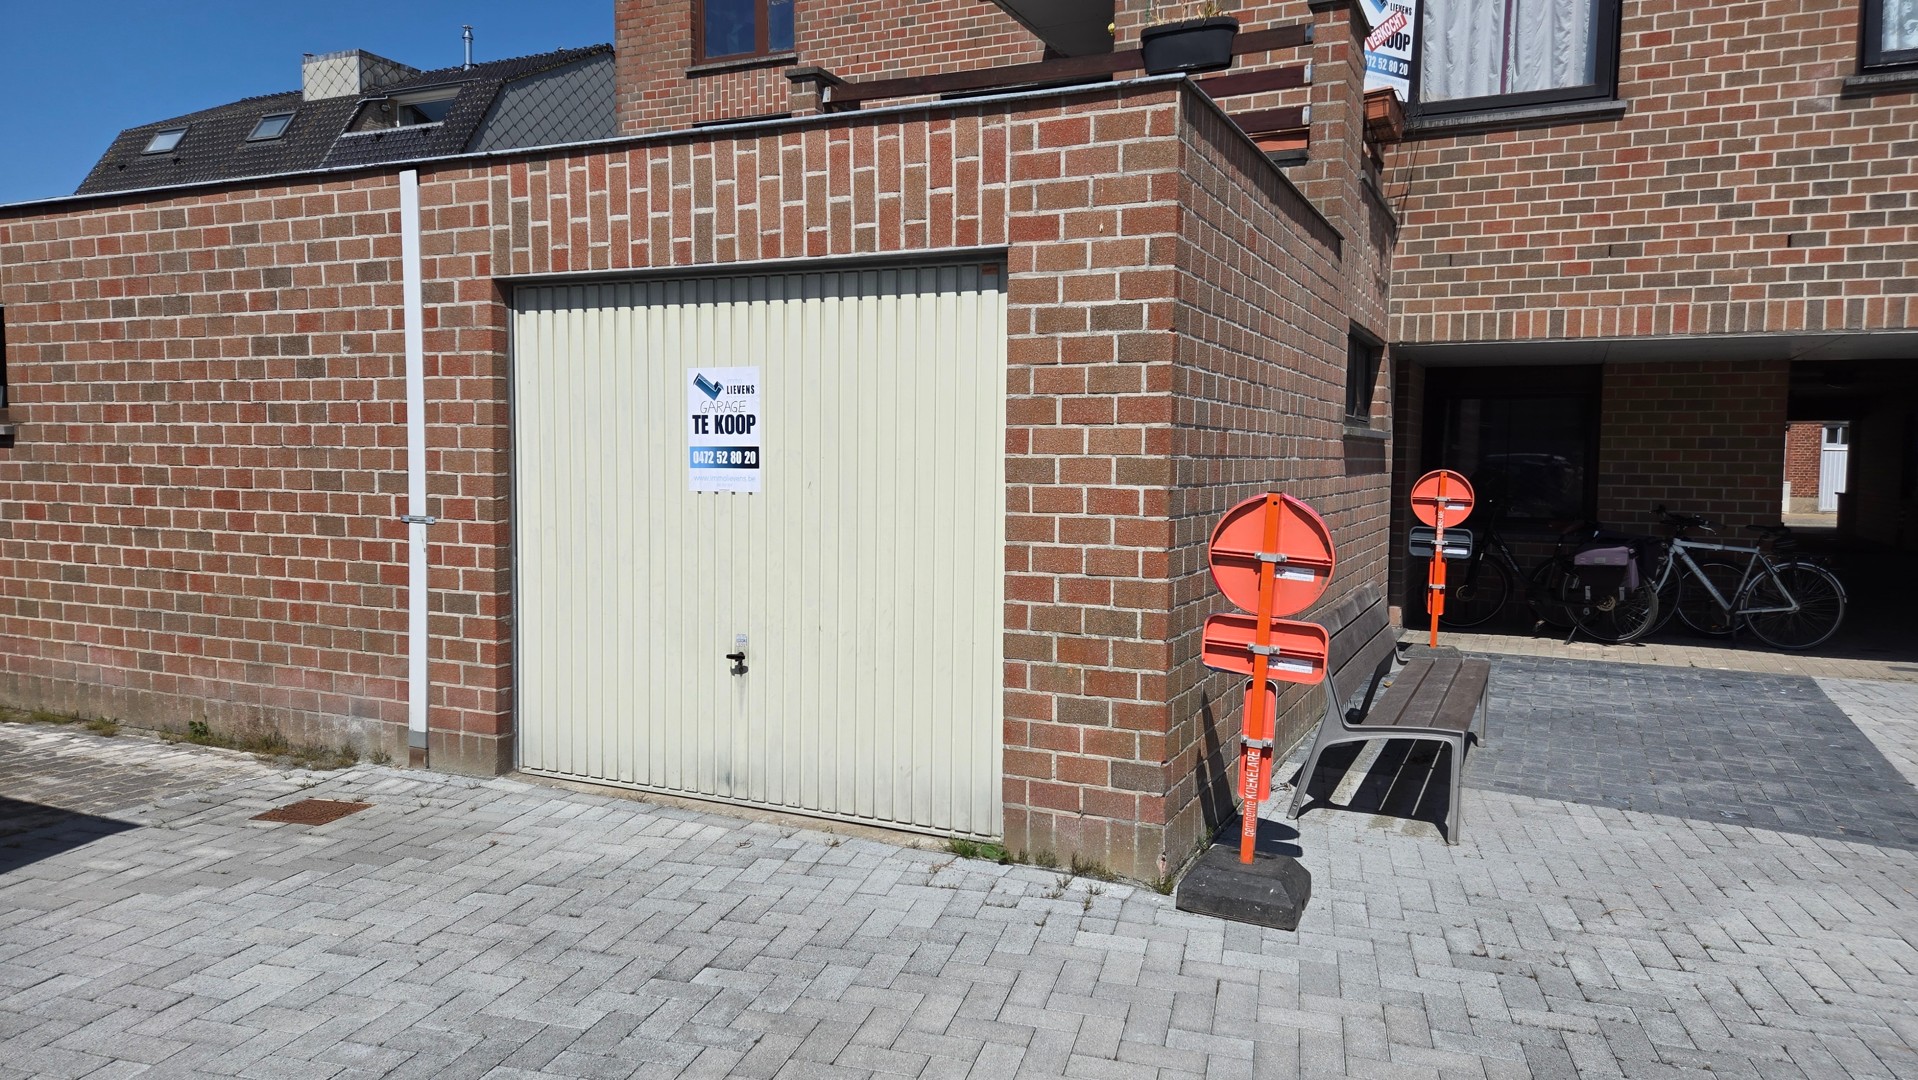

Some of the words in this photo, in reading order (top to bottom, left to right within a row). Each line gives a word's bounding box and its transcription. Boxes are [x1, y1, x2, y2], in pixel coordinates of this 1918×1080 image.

[1367, 12, 1405, 49] VERKOCHT
[1382, 32, 1410, 52] OOP
[1378, 57, 1387, 70] 52
[1388, 60, 1398, 73] 80
[1399, 62, 1408, 76] 20
[726, 385, 755, 395] LIEVENS
[700, 400, 747, 413] GARAGE
[692, 414, 709, 434] TE
[714, 414, 756, 434] KOOP
[693, 451, 714, 464] 0472
[716, 451, 728, 464] 52
[730, 451, 742, 464] 80
[744, 451, 756, 464] 20
[1246, 751, 1260, 799] KOEKELARE
[1245, 801, 1256, 837] gemeente
